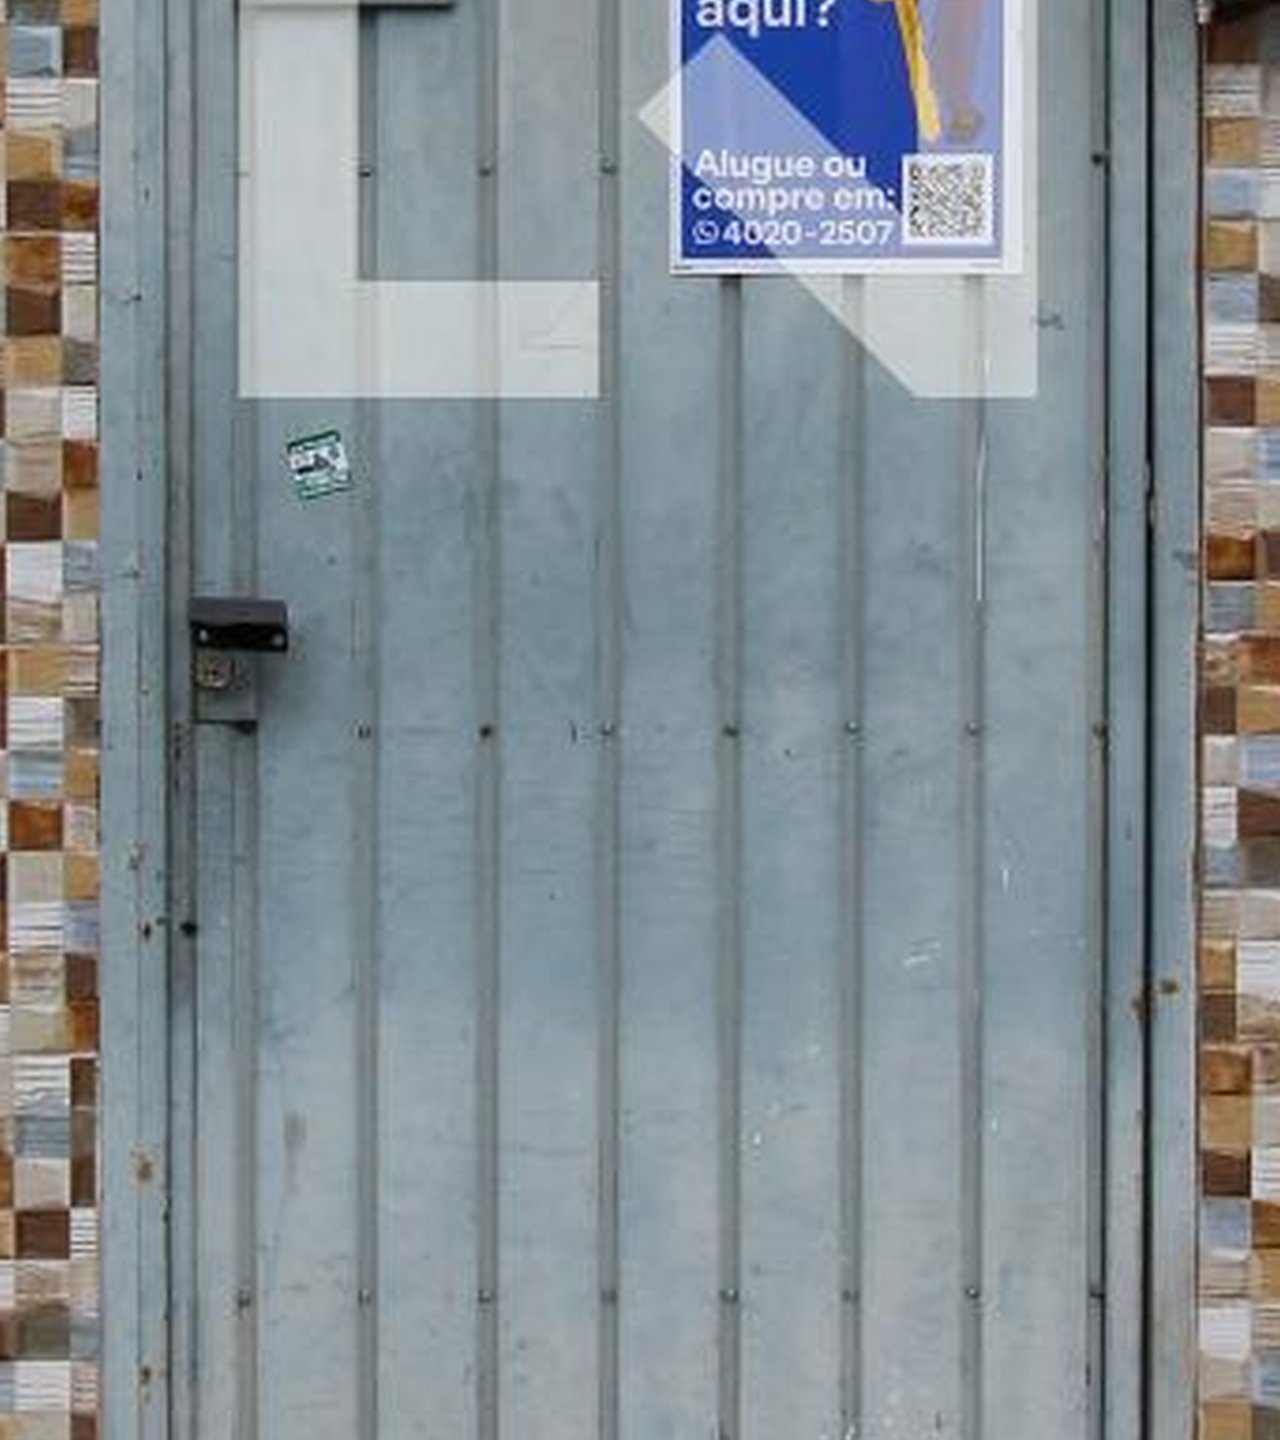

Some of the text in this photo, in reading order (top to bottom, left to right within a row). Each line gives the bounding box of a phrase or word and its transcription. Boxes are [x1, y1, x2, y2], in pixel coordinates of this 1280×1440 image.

[693, 149, 867, 184] Alugue ou
[691, 186, 896, 214] compre em:
